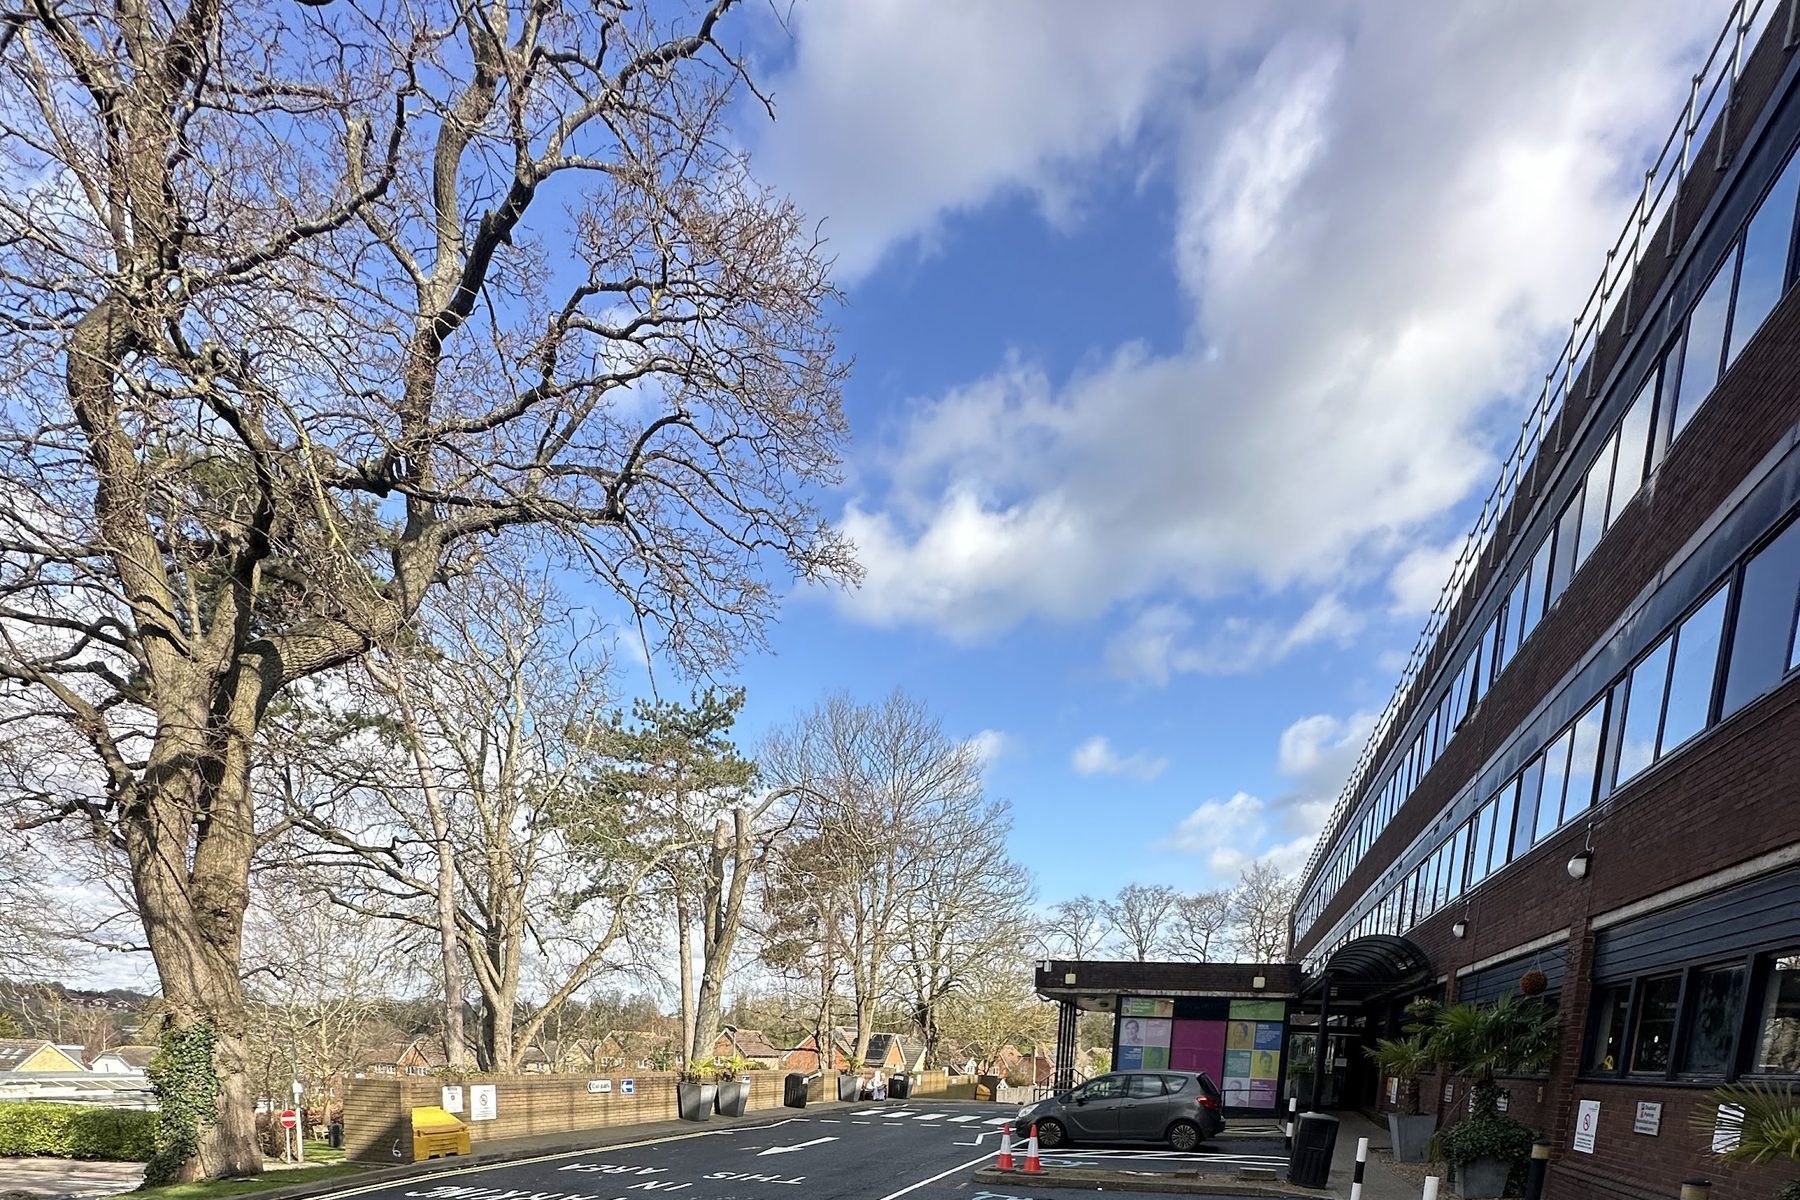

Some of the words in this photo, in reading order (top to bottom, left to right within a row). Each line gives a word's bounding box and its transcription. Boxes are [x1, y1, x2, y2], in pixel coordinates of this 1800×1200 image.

[558, 1163, 668, 1175] AREA
[703, 1171, 806, 1185] THIS
[626, 1180, 693, 1191] IN
